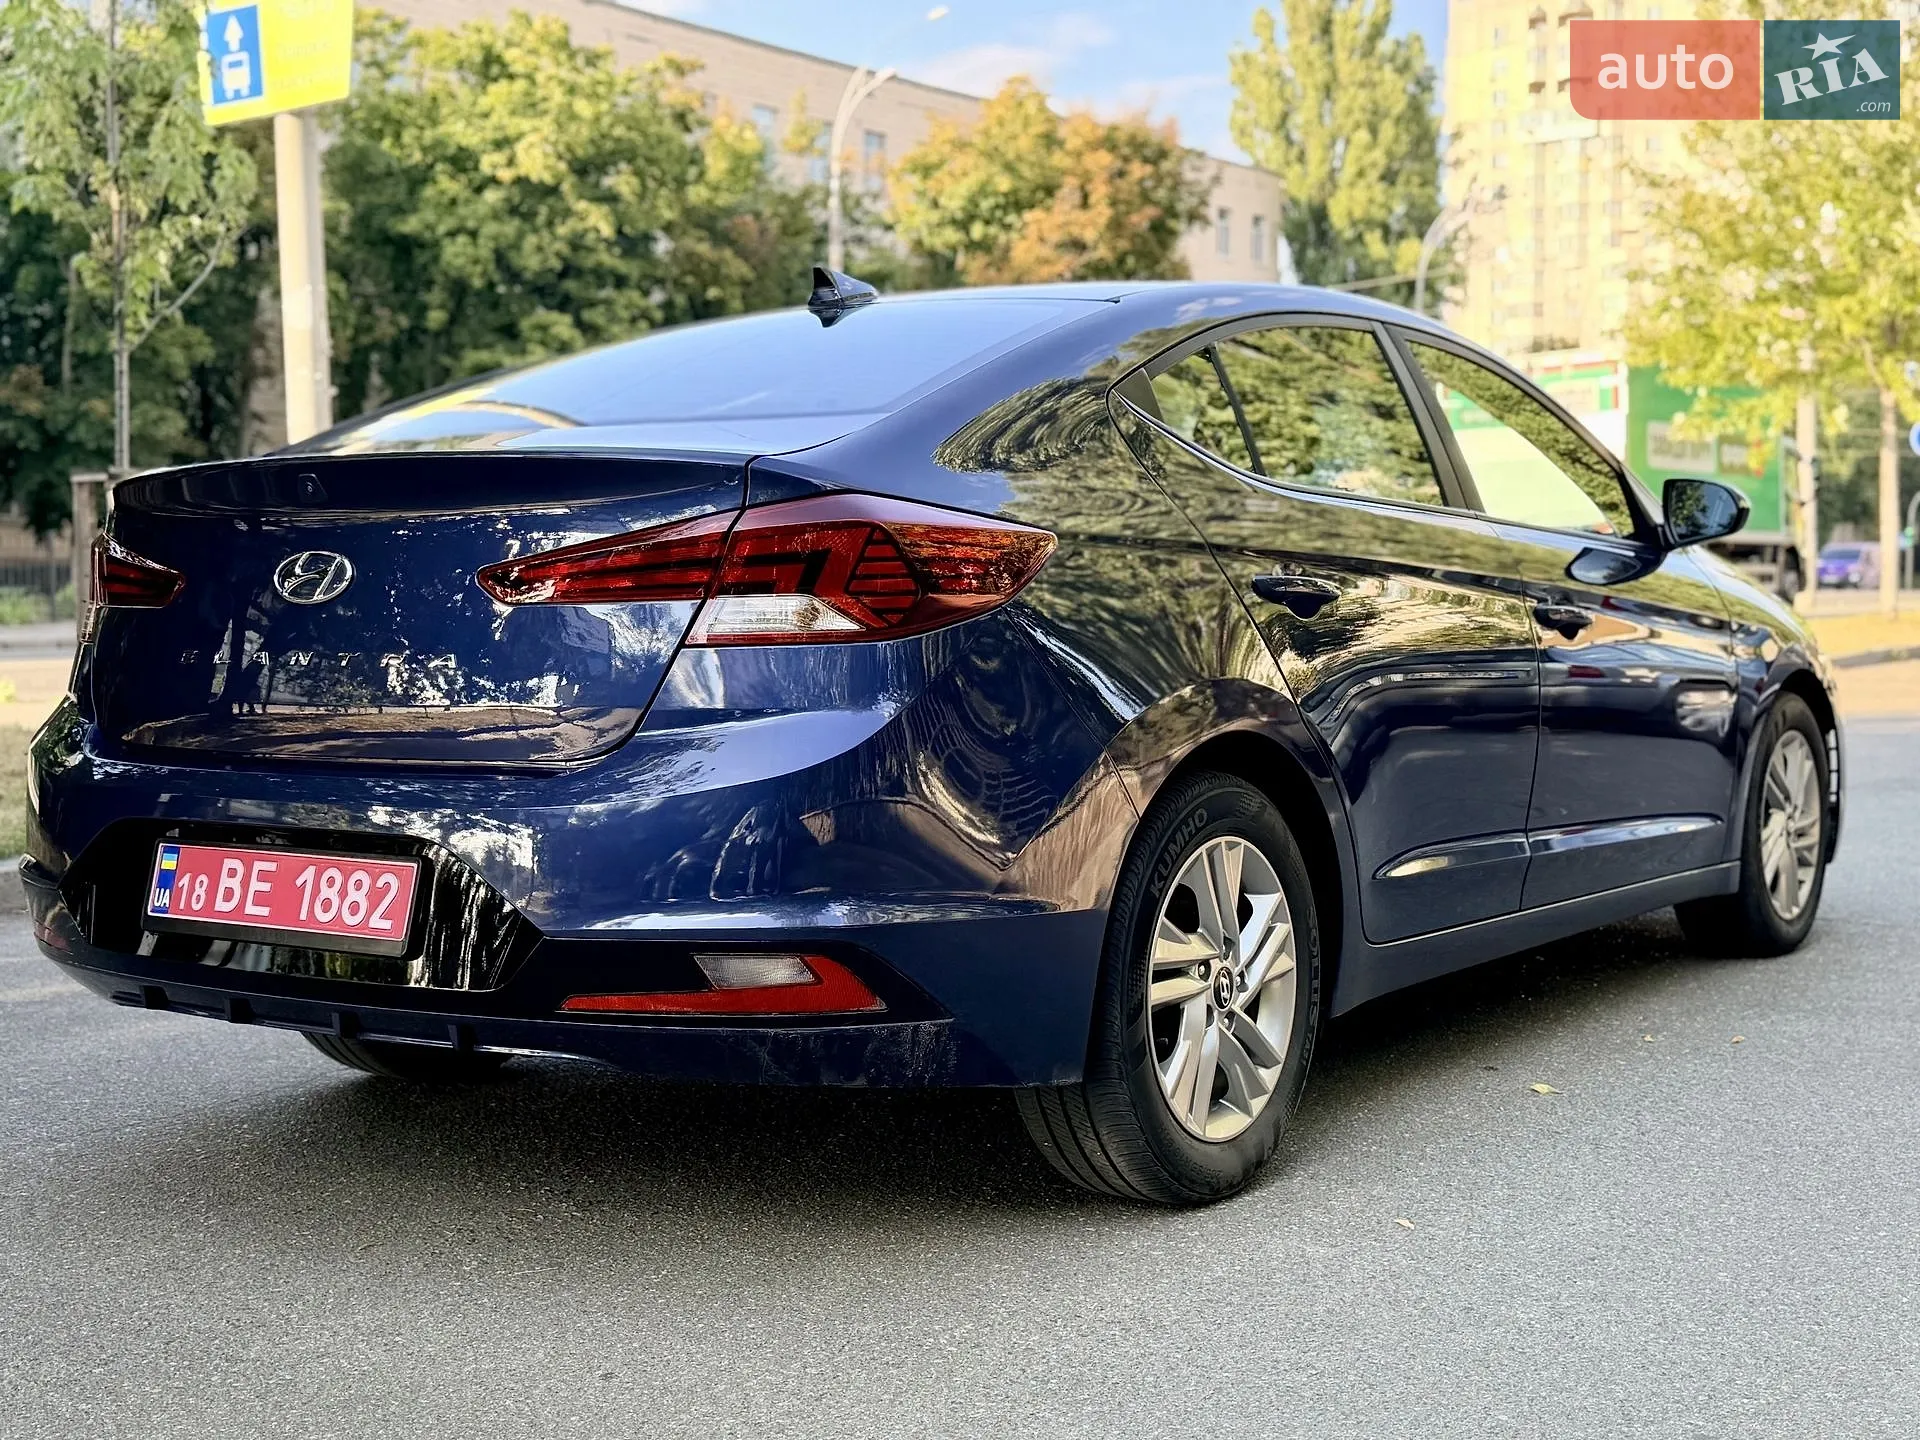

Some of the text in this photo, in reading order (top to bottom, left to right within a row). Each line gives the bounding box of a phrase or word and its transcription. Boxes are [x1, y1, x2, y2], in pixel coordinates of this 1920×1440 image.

[180, 650, 457, 668] ELANTRA
[1150, 808, 1208, 898] KUMHO
[153, 887, 170, 908] UA
[177, 858, 400, 931] 18 BE 1882
[1307, 906, 1319, 1026] SOLUS
